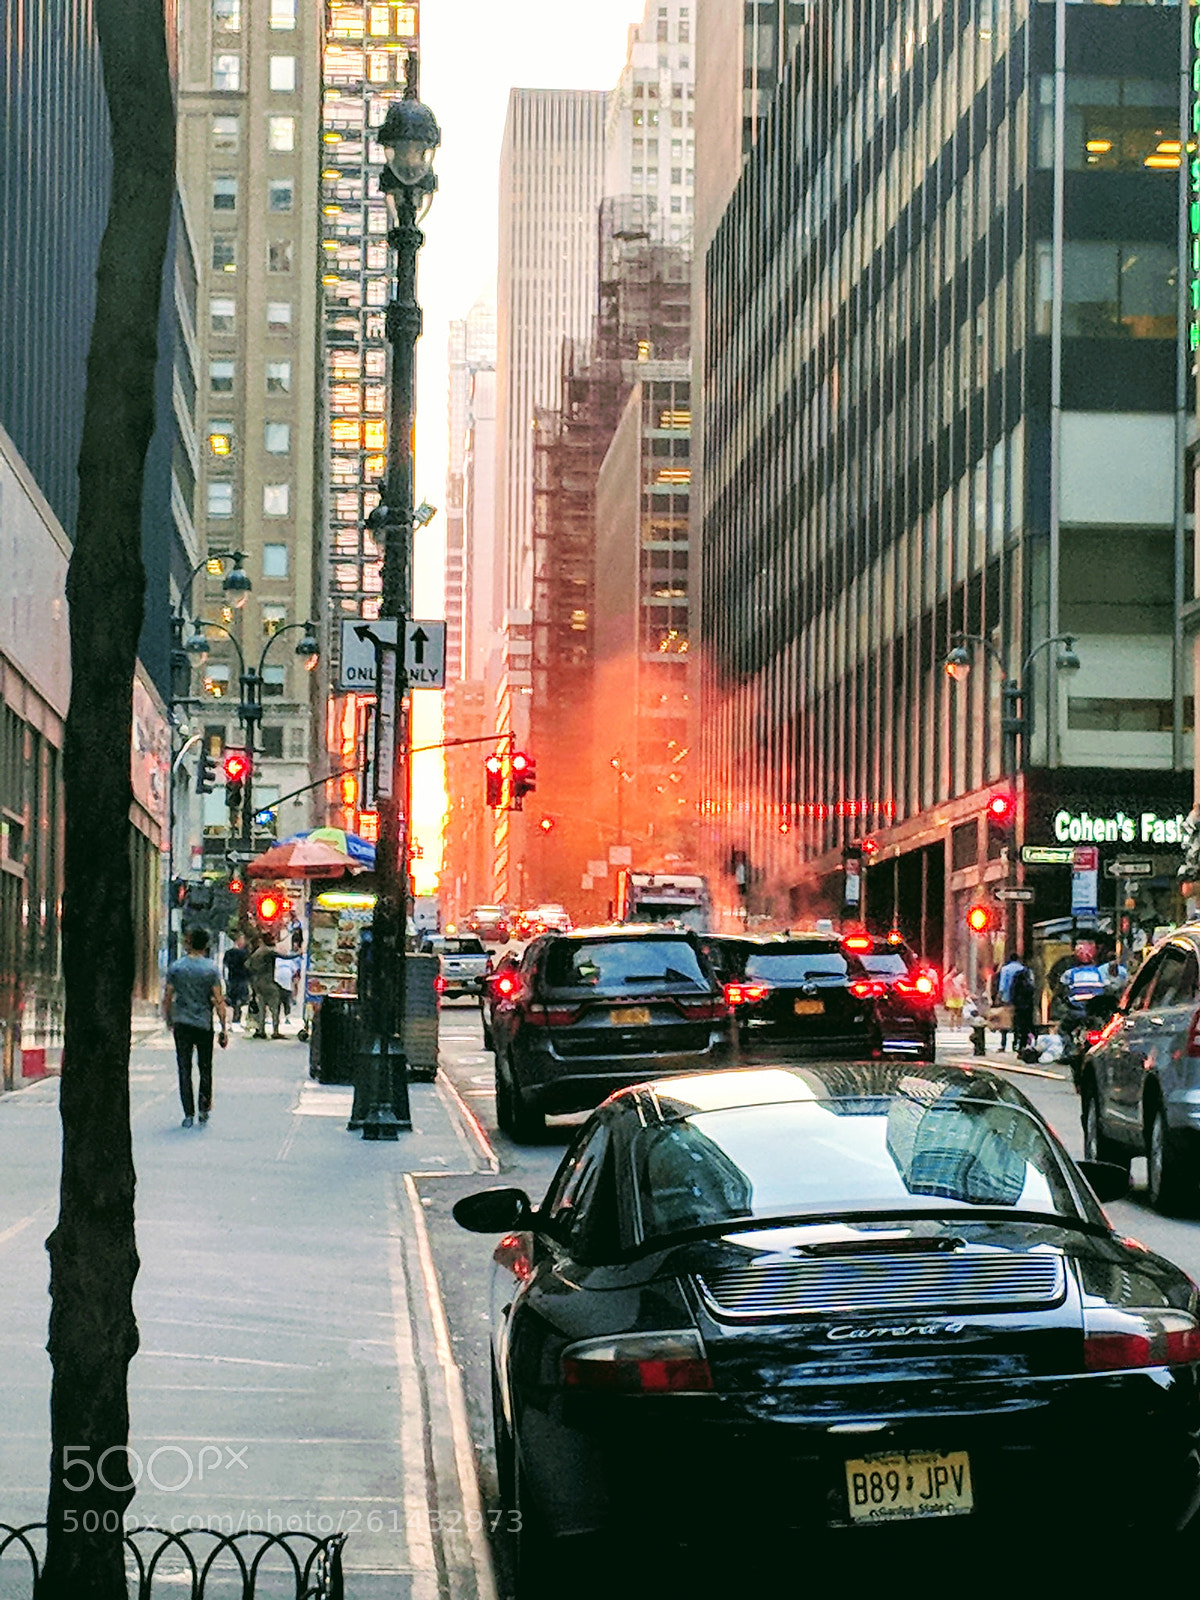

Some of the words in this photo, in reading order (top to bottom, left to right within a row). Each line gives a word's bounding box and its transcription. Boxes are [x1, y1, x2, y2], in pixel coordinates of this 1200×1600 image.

[346, 667, 377, 681] ONL
[407, 668, 439, 682] NLY
[1055, 810, 1136, 843] Cohen's
[826, 1325, 938, 1341] Carrera
[944, 1321, 966, 1334] 4
[852, 1470, 899, 1505] B89
[919, 1464, 964, 1500] JPV
